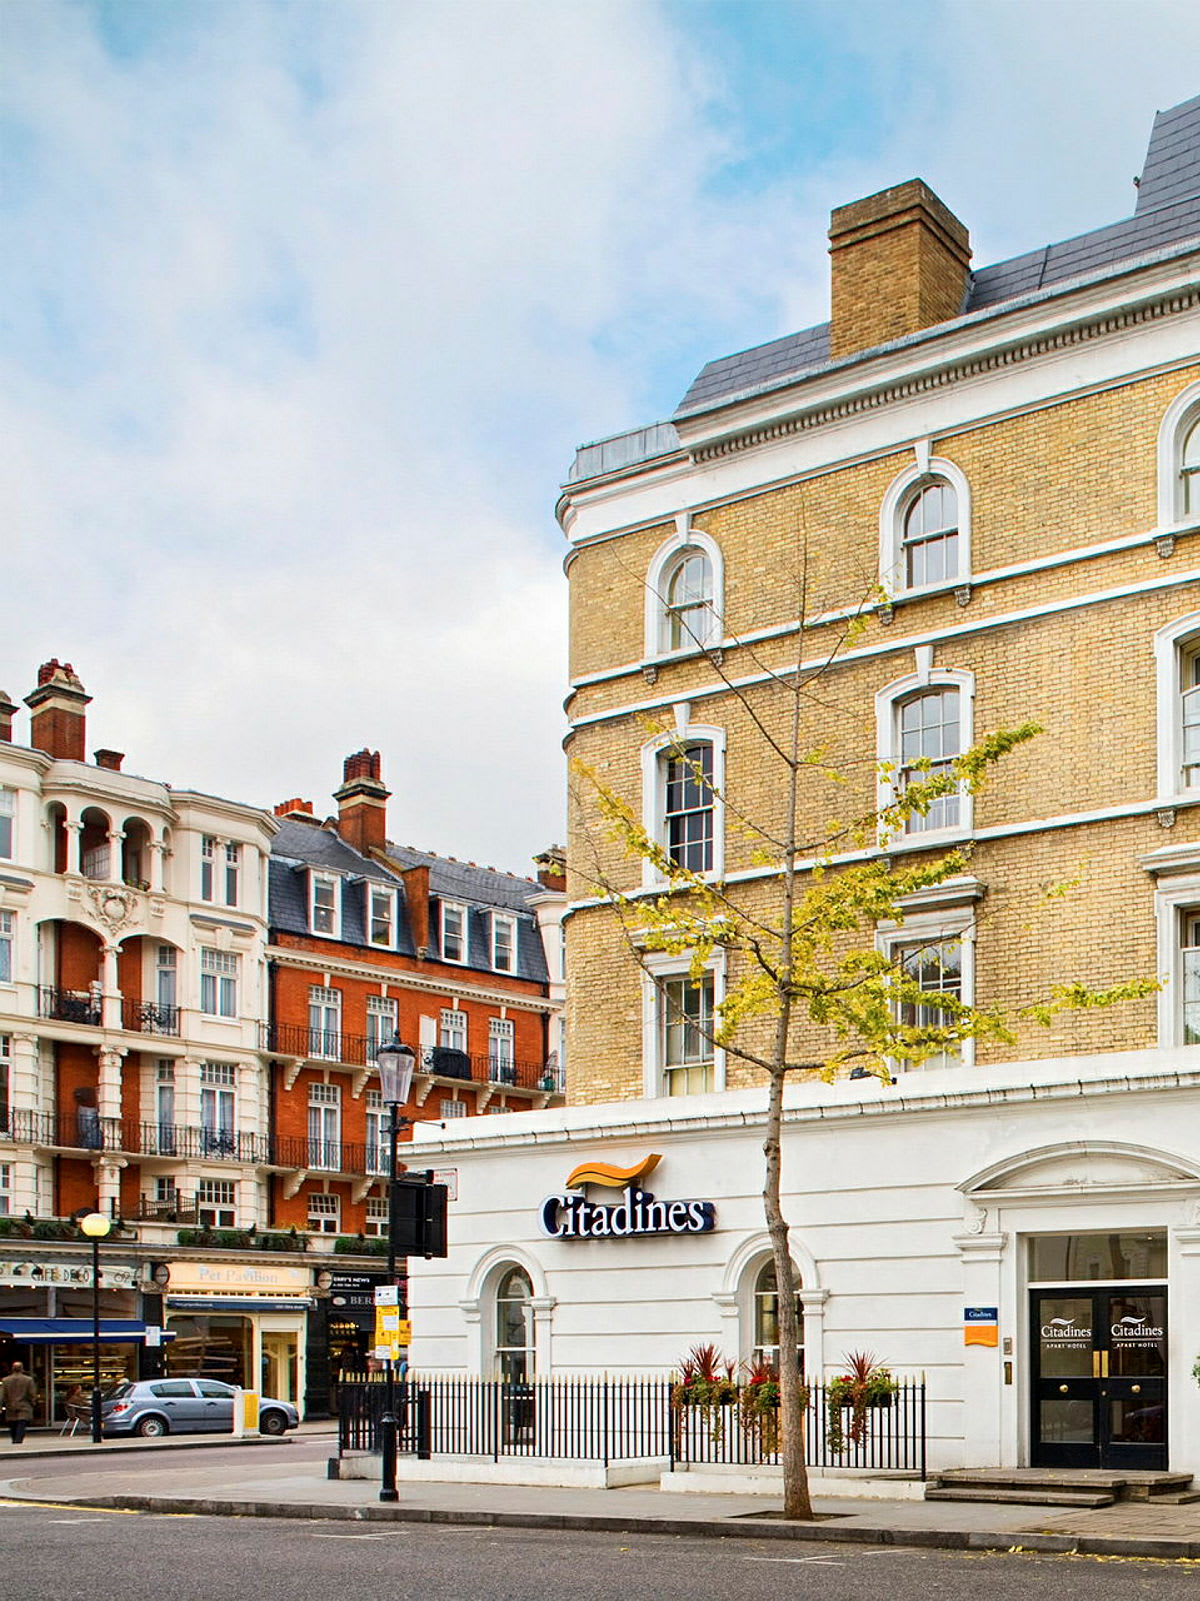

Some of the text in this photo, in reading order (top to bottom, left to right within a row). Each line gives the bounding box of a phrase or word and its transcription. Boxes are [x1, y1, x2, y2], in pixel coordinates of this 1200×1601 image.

[539, 1187, 705, 1237] Citadines
[200, 1268, 278, 1284] Pet Pavilion
[1041, 1325, 1092, 1338] Citadines
[1111, 1323, 1164, 1337] Citadines
